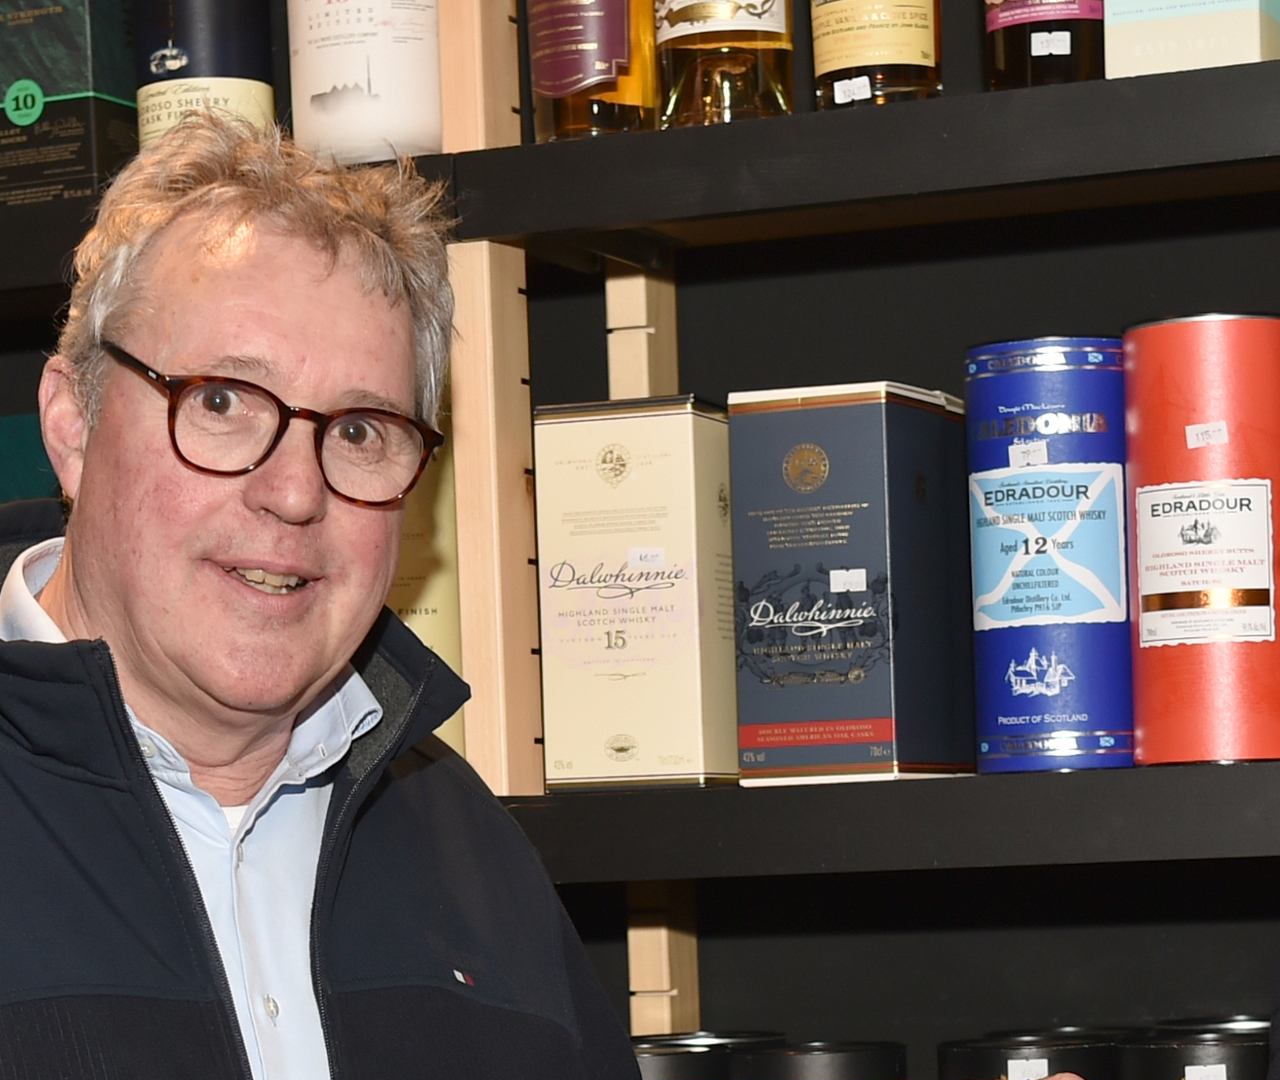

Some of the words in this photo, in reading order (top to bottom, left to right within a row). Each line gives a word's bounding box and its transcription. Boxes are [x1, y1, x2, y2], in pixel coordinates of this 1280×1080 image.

[12, 94, 35, 112] 10
[984, 484, 1090, 506] EDRADOUR
[1027, 512, 1046, 523] MALT
[1048, 511, 1077, 522] SCOTCH
[1078, 510, 1107, 521] WHISKY
[1151, 497, 1253, 518] EDRADOUR
[1000, 540, 1018, 556] Aged
[1022, 536, 1048, 555] 12
[1051, 538, 1074, 550] Years
[1236, 558, 1266, 566] MALT
[549, 560, 686, 597] Dalwhinnie
[1159, 568, 1198, 578] SCOTCH
[558, 608, 608, 618] HIGHLAND
[613, 606, 646, 615] SINGLE
[651, 605, 675, 613] MALT
[749, 599, 877, 637] Dalwhinnie
[577, 618, 615, 627] SCOTCH
[619, 616, 656, 625] WHISKY
[604, 630, 627, 650] 15
[998, 715, 1030, 725] PRODUCT
[1043, 713, 1089, 723] SCOTLAND
